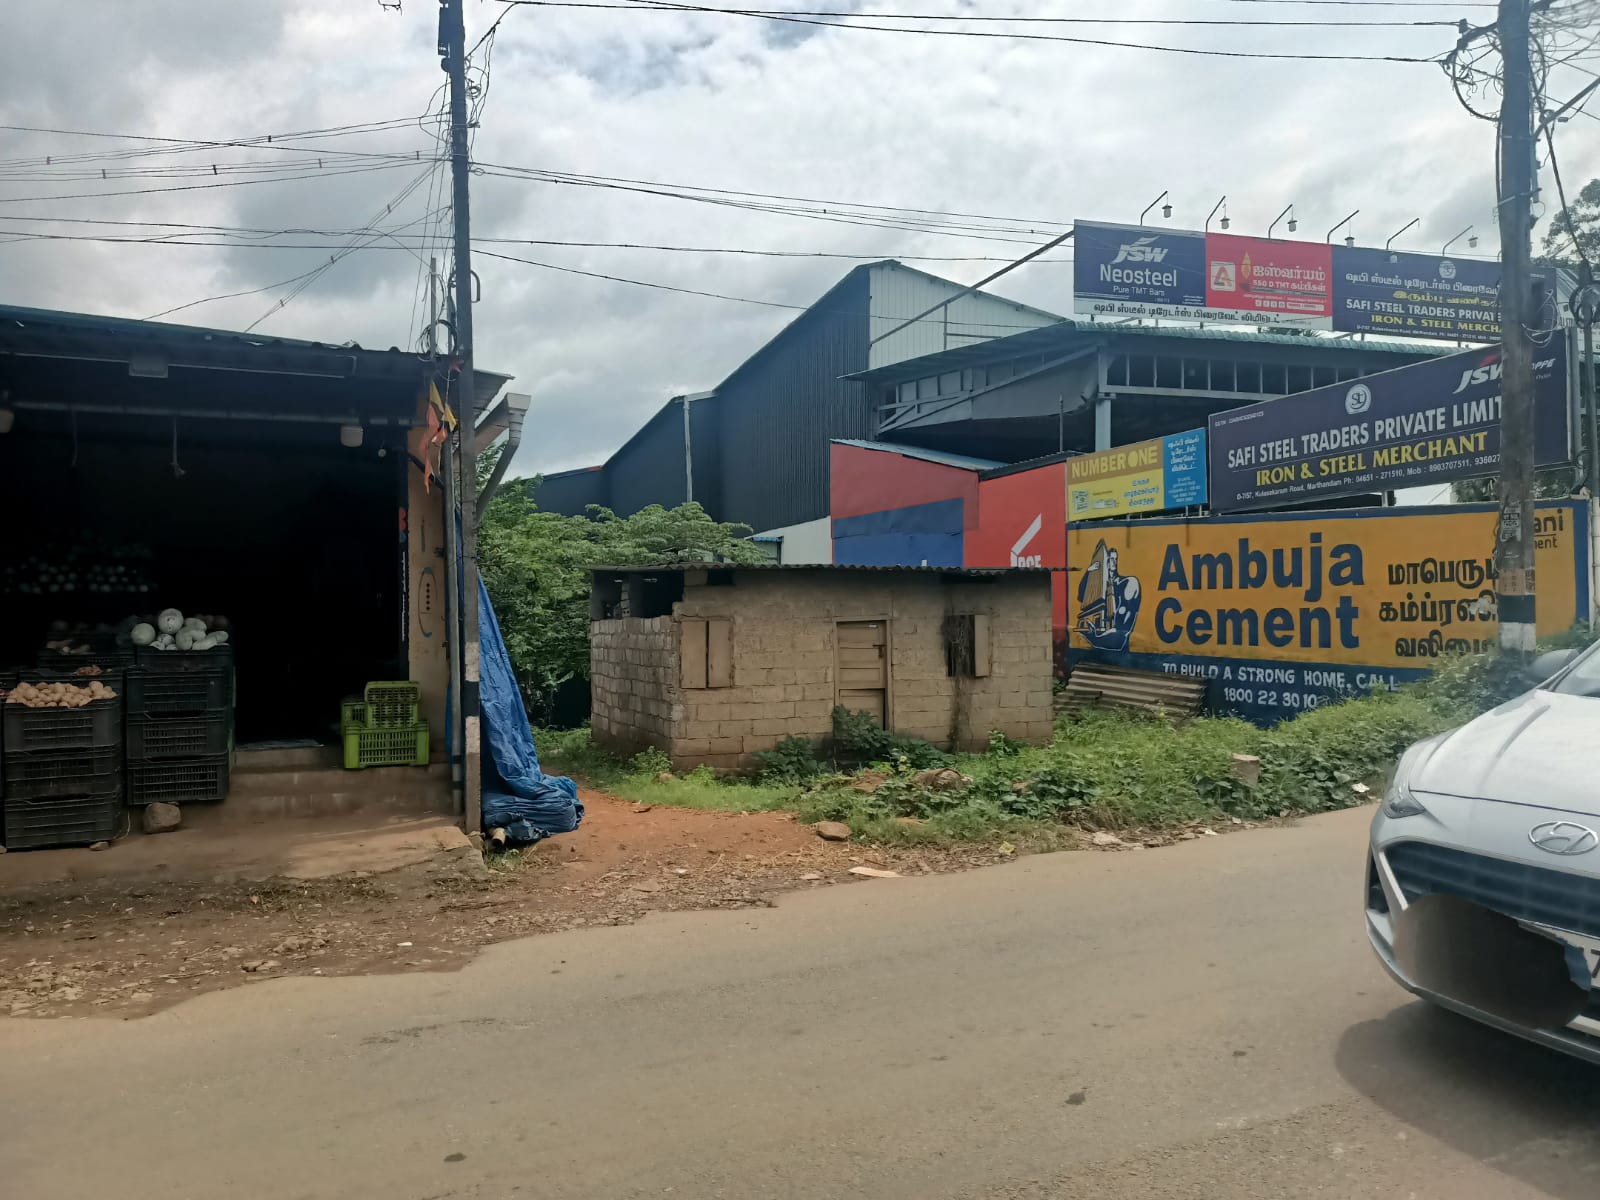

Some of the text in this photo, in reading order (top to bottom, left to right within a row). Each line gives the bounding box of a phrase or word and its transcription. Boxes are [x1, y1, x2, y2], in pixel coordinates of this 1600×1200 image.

[1110, 244, 1168, 265] JSW
[1100, 263, 1177, 287] Neosteel
[1253, 279, 1268, 287] 550
[1275, 281, 1290, 289] TMT
[1113, 285, 1130, 294] Pure
[1132, 286, 1148, 295] TMT
[1346, 299, 1371, 311] SAFI
[1374, 301, 1405, 314] STEEL
[1408, 304, 1456, 318] TRADERS
[1371, 314, 1403, 325] IRON
[1406, 316, 1416, 325] &
[1421, 319, 1453, 329] STEEL
[1457, 322, 1502, 333] MERCH
[1228, 395, 1502, 469] SAFI STEEL TRADERS PRIVATE LIMIT
[1071, 444, 1158, 479] NUMBER ONE
[1256, 431, 1488, 486] IRON & STEEL MERCHANT
[1474, 454, 1501, 466] 936027
[1534, 508, 1564, 533] ani
[1534, 536, 1558, 550] ent
[1157, 531, 1365, 603] Ambuja
[1154, 596, 1361, 649] Cement
[1180, 663, 1219, 680] BUILD
[1222, 665, 1233, 681] A
[1237, 666, 1295, 684] STRONG
[1356, 673, 1399, 691] CALL
[1223, 687, 1253, 703] 1800
[1257, 690, 1278, 706] 22
